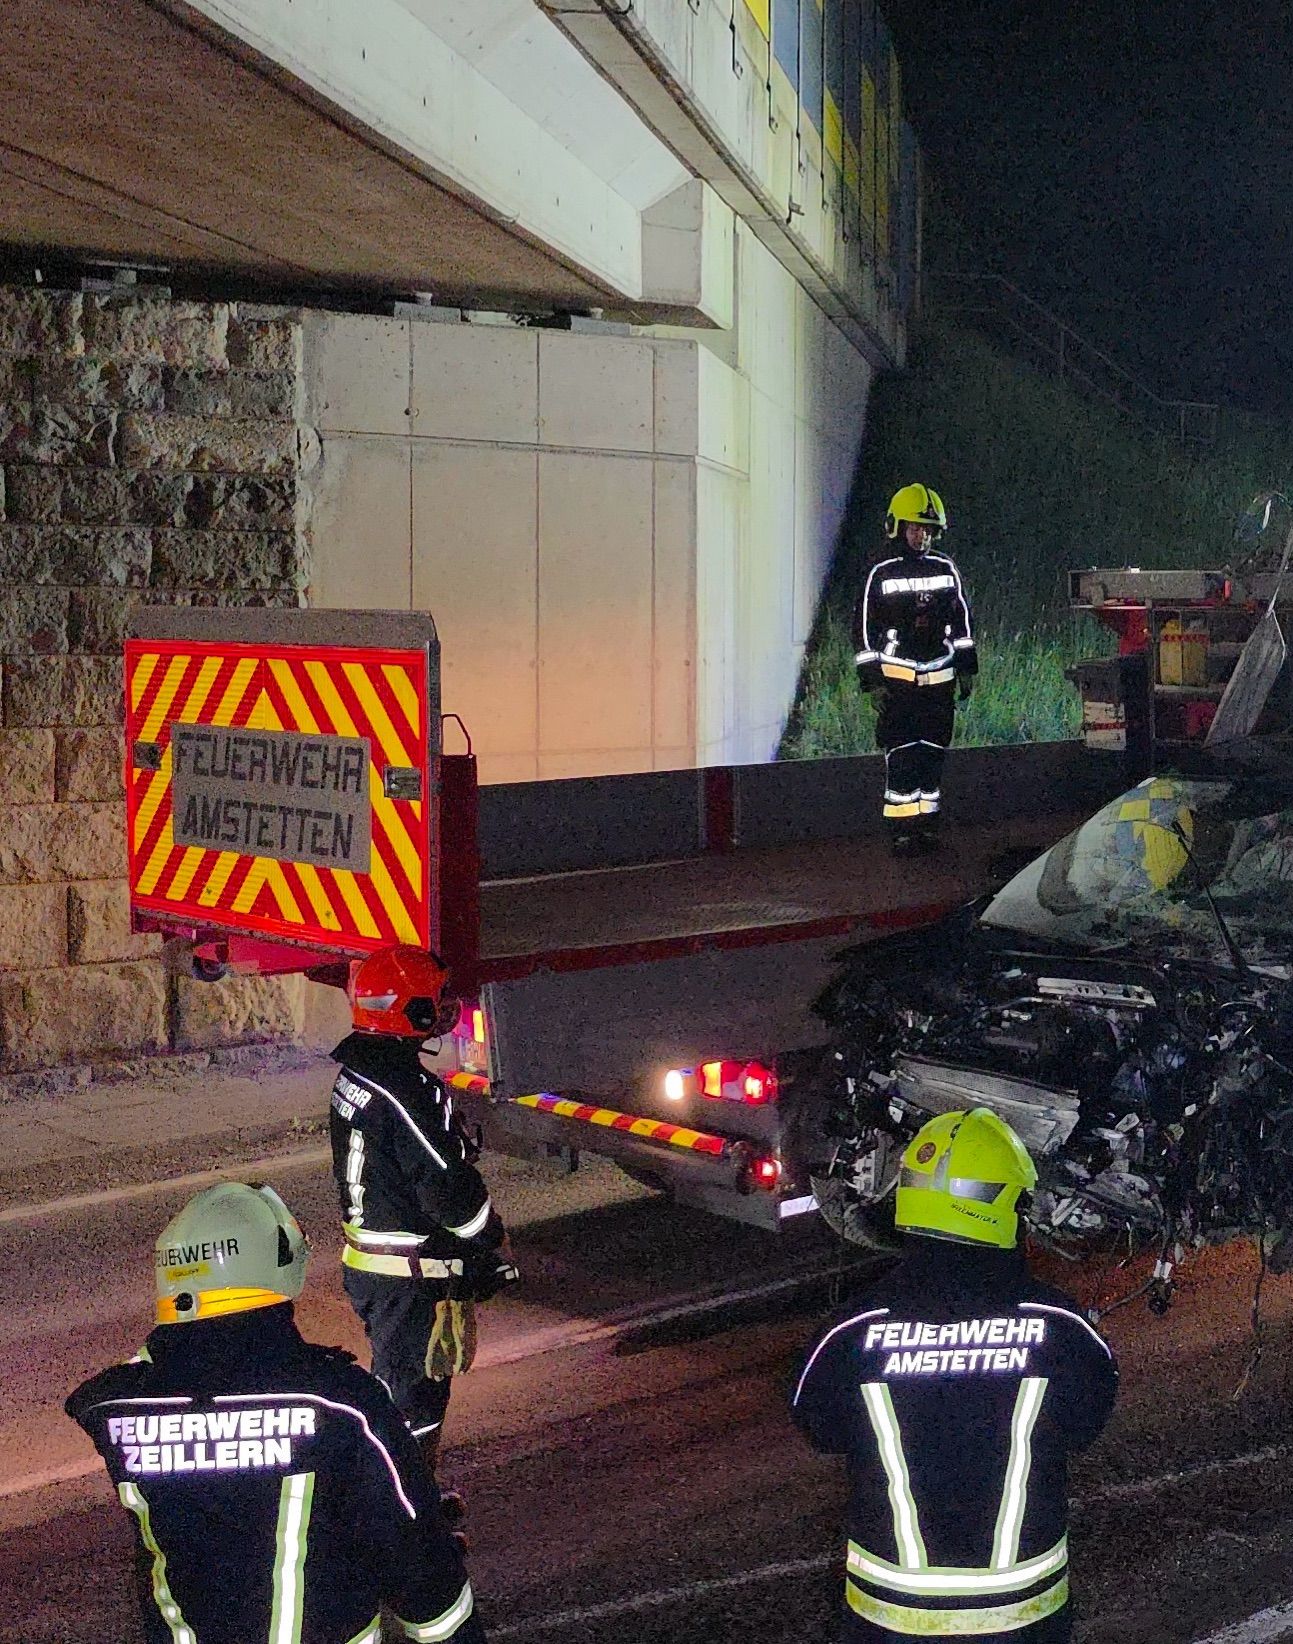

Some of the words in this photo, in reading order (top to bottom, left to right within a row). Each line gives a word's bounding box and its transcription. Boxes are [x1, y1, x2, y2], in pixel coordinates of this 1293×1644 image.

[176, 732, 364, 794] FEUERWEHR
[181, 795, 353, 859] AMSTETTEN
[154, 1238, 239, 1267] EUERWEHR
[864, 1318, 1046, 1350] FEUERWEHR
[884, 1347, 1028, 1374] AMSTETTEN
[108, 1407, 315, 1445] FEUERWEHR
[122, 1437, 292, 1473] ZEILLERN
